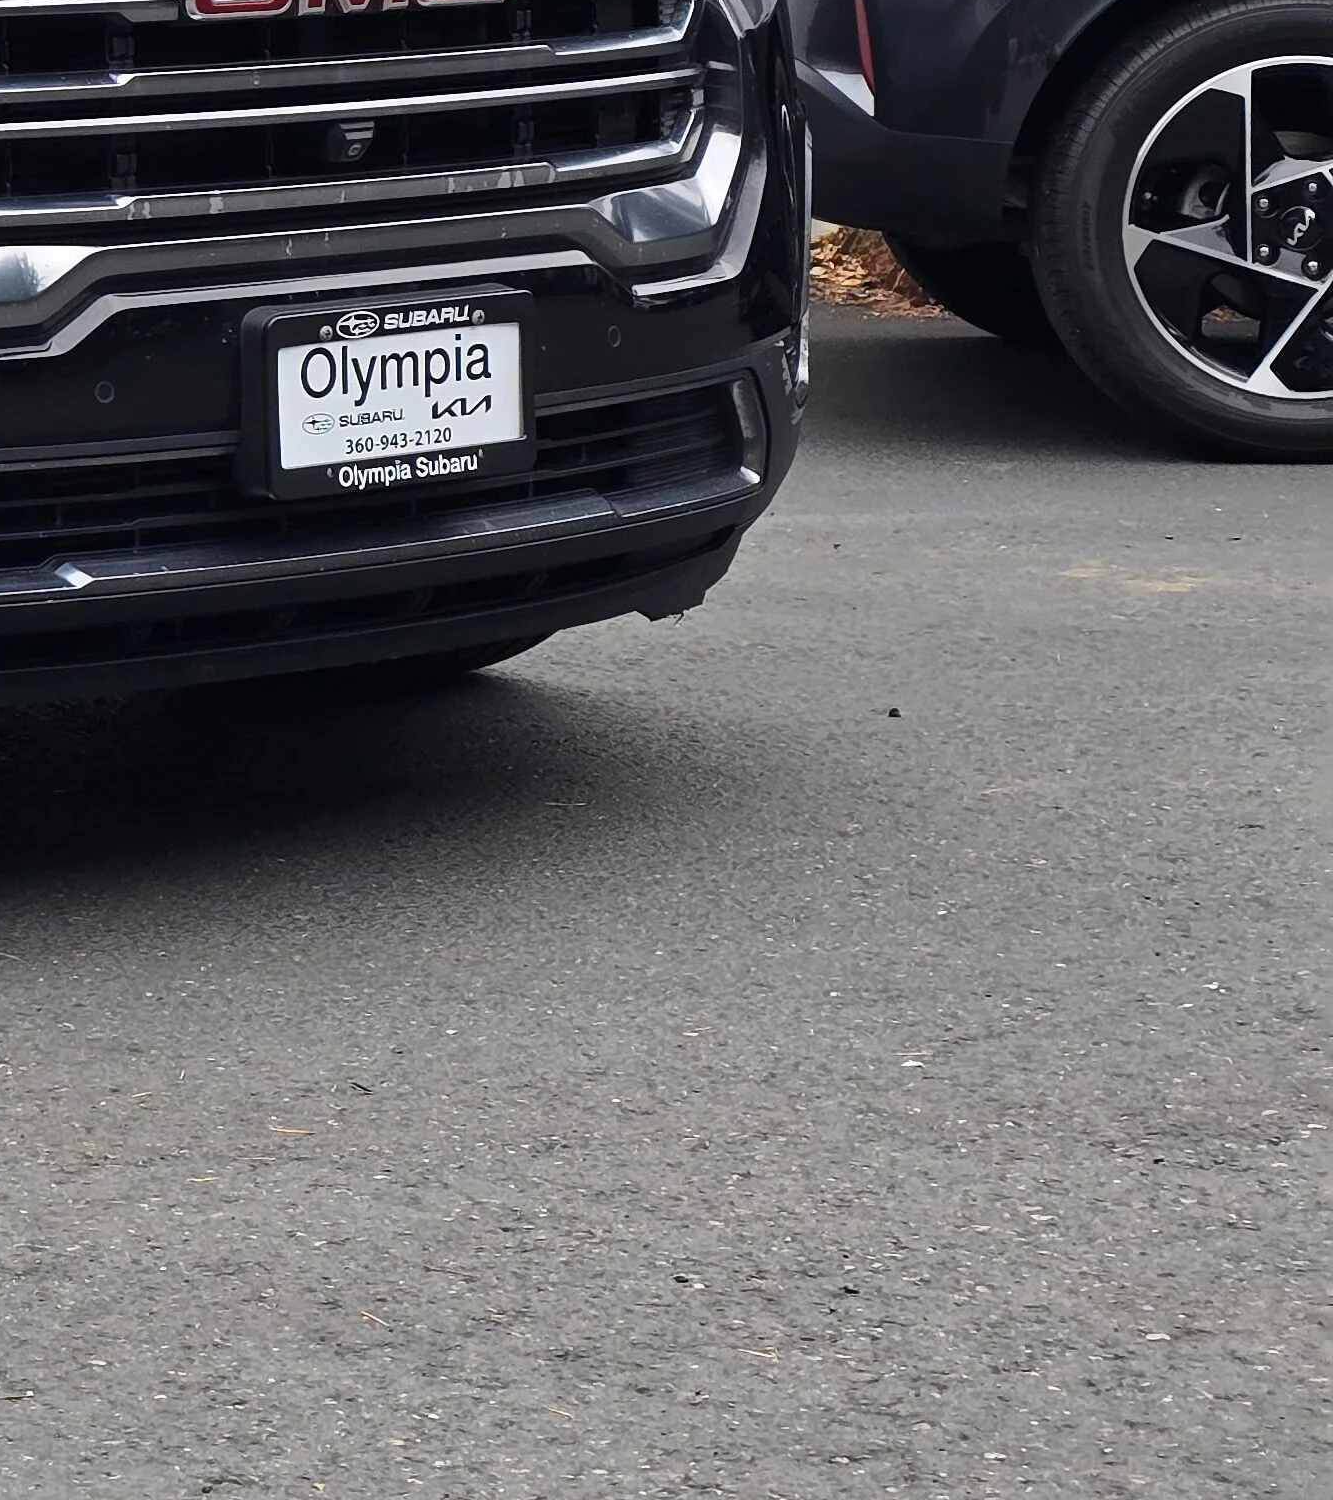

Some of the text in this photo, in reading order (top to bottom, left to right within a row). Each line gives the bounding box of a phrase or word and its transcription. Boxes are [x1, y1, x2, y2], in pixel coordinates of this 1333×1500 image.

[383, 303, 470, 330] SUBARU
[300, 332, 493, 407] Olympia
[345, 426, 452, 455] 360-943-2120
[338, 453, 479, 490] Olympia Subaru
